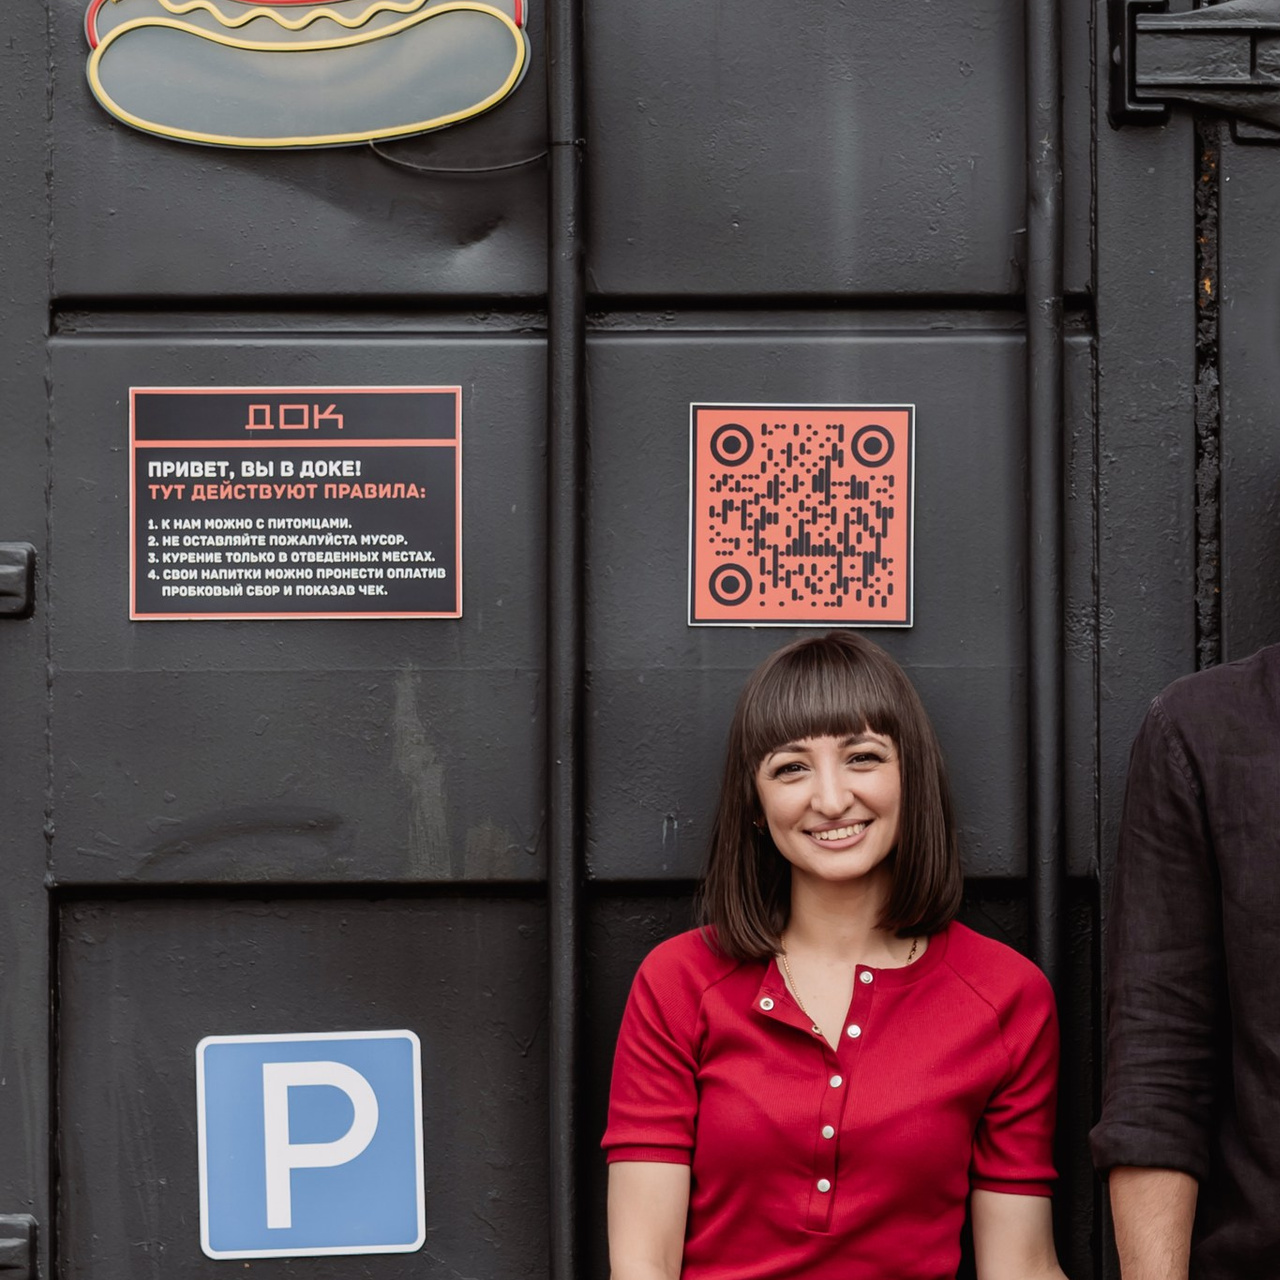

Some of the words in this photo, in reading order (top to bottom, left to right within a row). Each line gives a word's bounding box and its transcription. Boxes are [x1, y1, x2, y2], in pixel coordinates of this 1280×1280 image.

[244, 403, 344, 430] ДОК
[148, 460, 235, 480] ПРИВЕТ,
[241, 460, 274, 478] ВЫ
[280, 460, 295, 477] В
[299, 459, 362, 479] ДОКЕ!
[147, 484, 186, 500] ТУТ
[190, 480, 319, 502] ДЕЙСТВУЮТ
[324, 482, 426, 499] ПРАВИЛА:
[147, 518, 159, 530] 1.
[161, 518, 171, 530] К
[173, 518, 202, 530] НАМ
[204, 518, 253, 530] МОЖНО
[255, 517, 265, 530] С
[267, 517, 353, 530] ПИТОМЦАМИ.
[147, 535, 160, 547] 2.
[162, 535, 181, 547] НЕ
[182, 532, 267, 547] ОСТАВЛЯЙТЕ
[268, 532, 358, 547] ПОЖАЛУЙСТА
[360, 533, 408, 546] МУСОР.
[147, 552, 160, 564] 3.
[162, 551, 223, 564] КУРЕНИЕ
[224, 551, 276, 564] ТОЛЬКО
[278, 551, 288, 563] В
[290, 551, 380, 564] ОТВЕДЕННЫХ
[381, 550, 436, 563] МЕСТАХ.
[147, 568, 161, 580] 4.
[162, 568, 198, 581] СВОИ
[200, 568, 262, 580] НАПИТКИ
[264, 567, 314, 580] МОЖНО
[316, 567, 384, 580] ПРОНЕСТИ
[386, 567, 447, 579] ОПЛАТИВ
[161, 583, 244, 597] ПРОБКОВЫЙ
[245, 584, 281, 597] СБОР
[283, 584, 293, 596] И
[295, 584, 356, 597] ПОКАЗАВ
[358, 584, 389, 596] ЧЕК.
[262, 1060, 380, 1230] P
